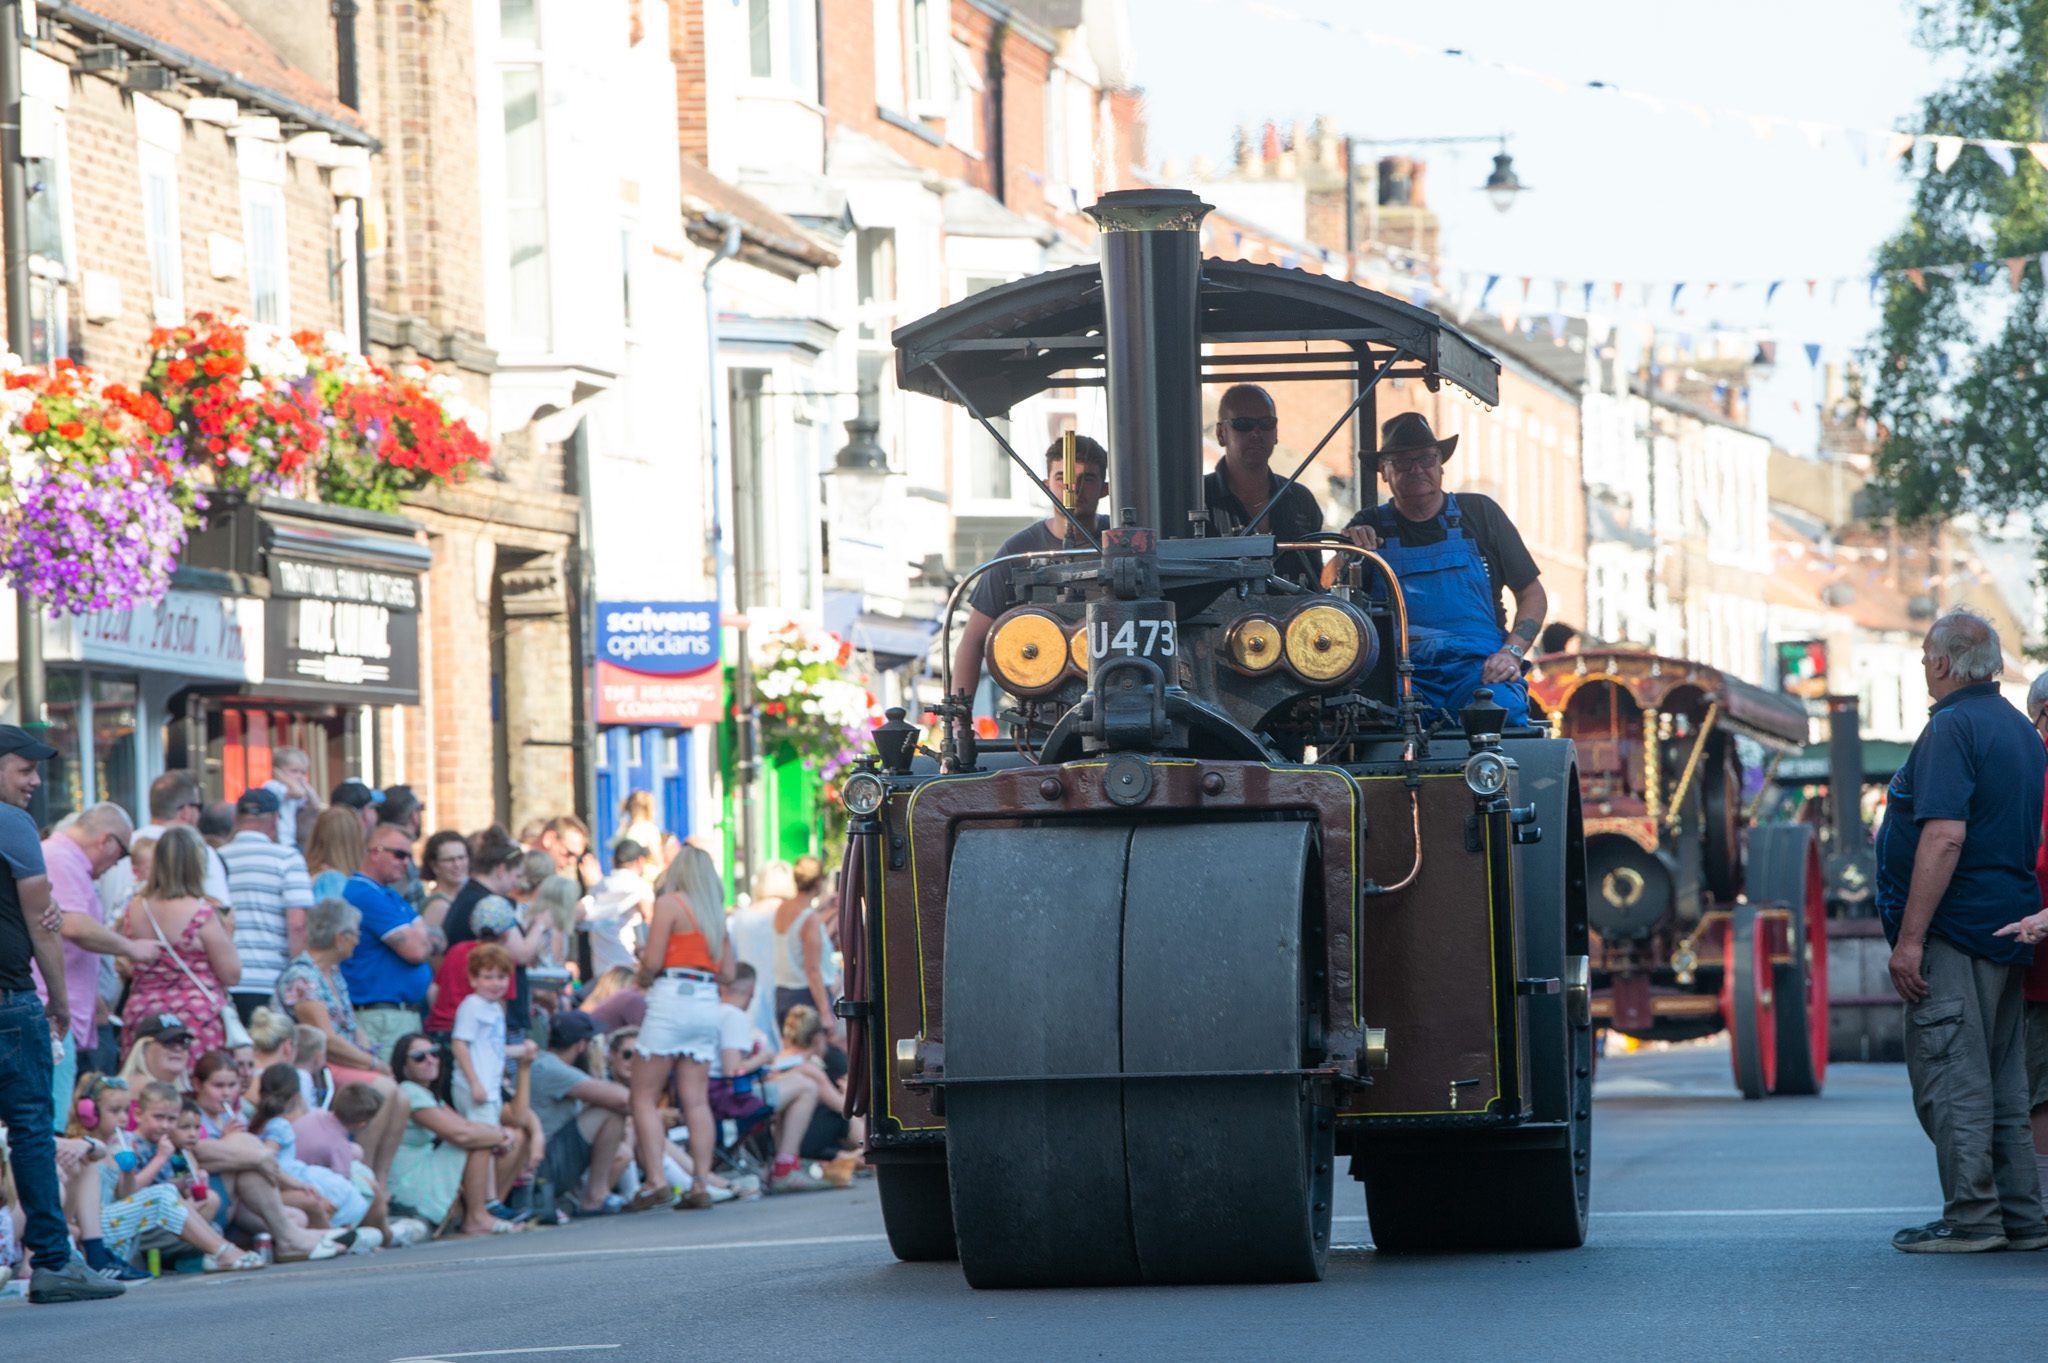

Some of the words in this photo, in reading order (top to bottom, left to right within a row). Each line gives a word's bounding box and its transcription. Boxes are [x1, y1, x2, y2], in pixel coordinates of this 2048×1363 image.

[607, 606, 711, 632] scrivens
[607, 633, 711, 661] opticians
[1091, 619, 1179, 659] U473
[603, 685, 635, 701] THE
[640, 684, 717, 701] HEARING
[616, 701, 700, 717] COMPANY
